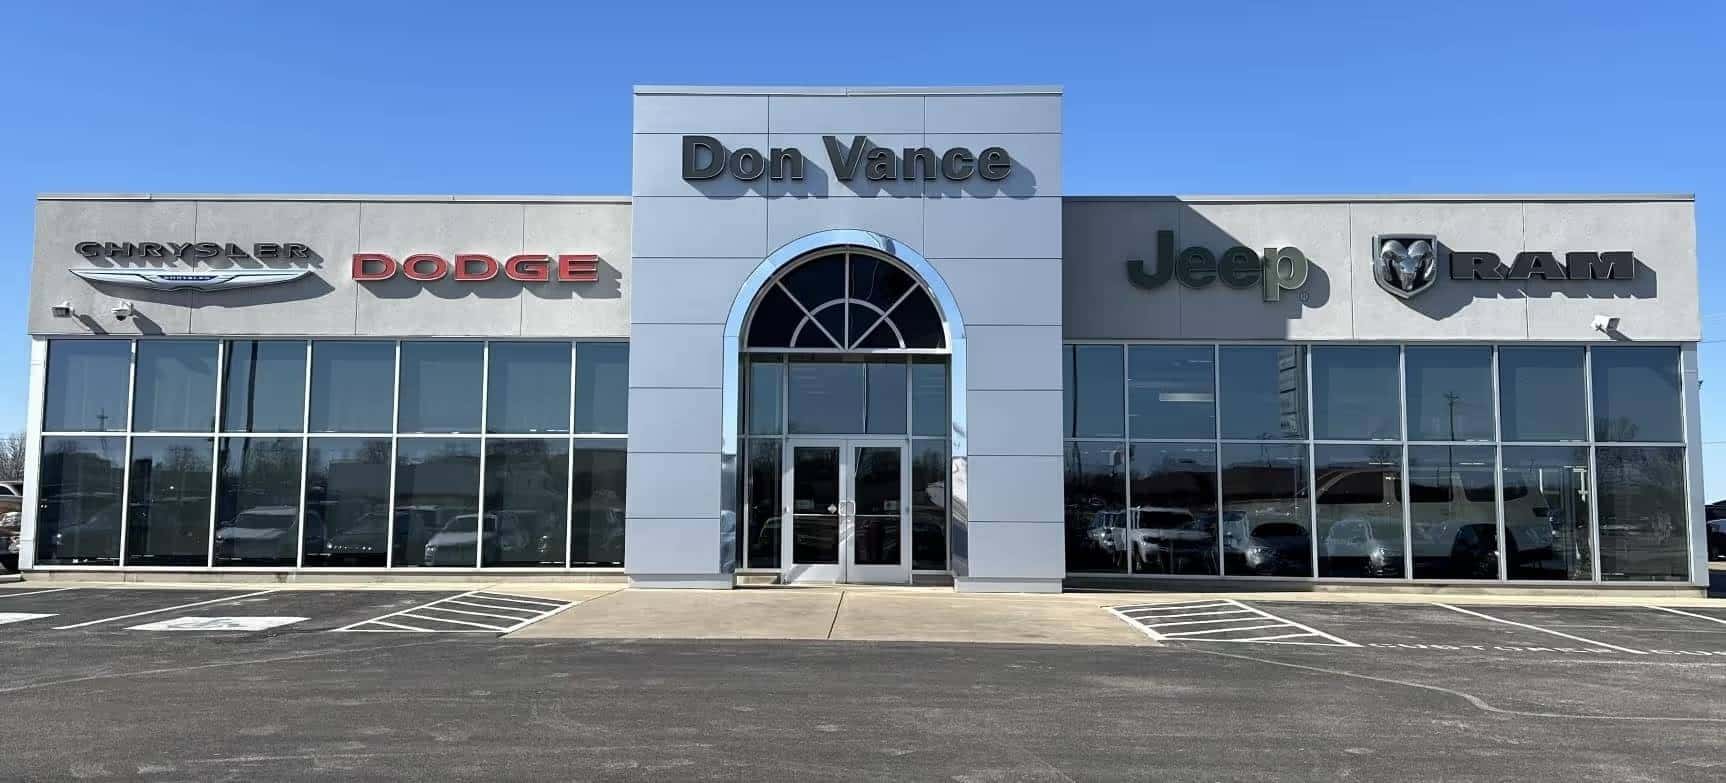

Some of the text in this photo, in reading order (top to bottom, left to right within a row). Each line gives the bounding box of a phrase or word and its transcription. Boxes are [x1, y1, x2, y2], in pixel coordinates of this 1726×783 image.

[682, 135, 1012, 181] Don Vance
[74, 241, 310, 258] CHRYSLER
[352, 253, 600, 282] DODGE
[1127, 230, 1309, 302] Jeep
[1450, 250, 1635, 280] RAM
